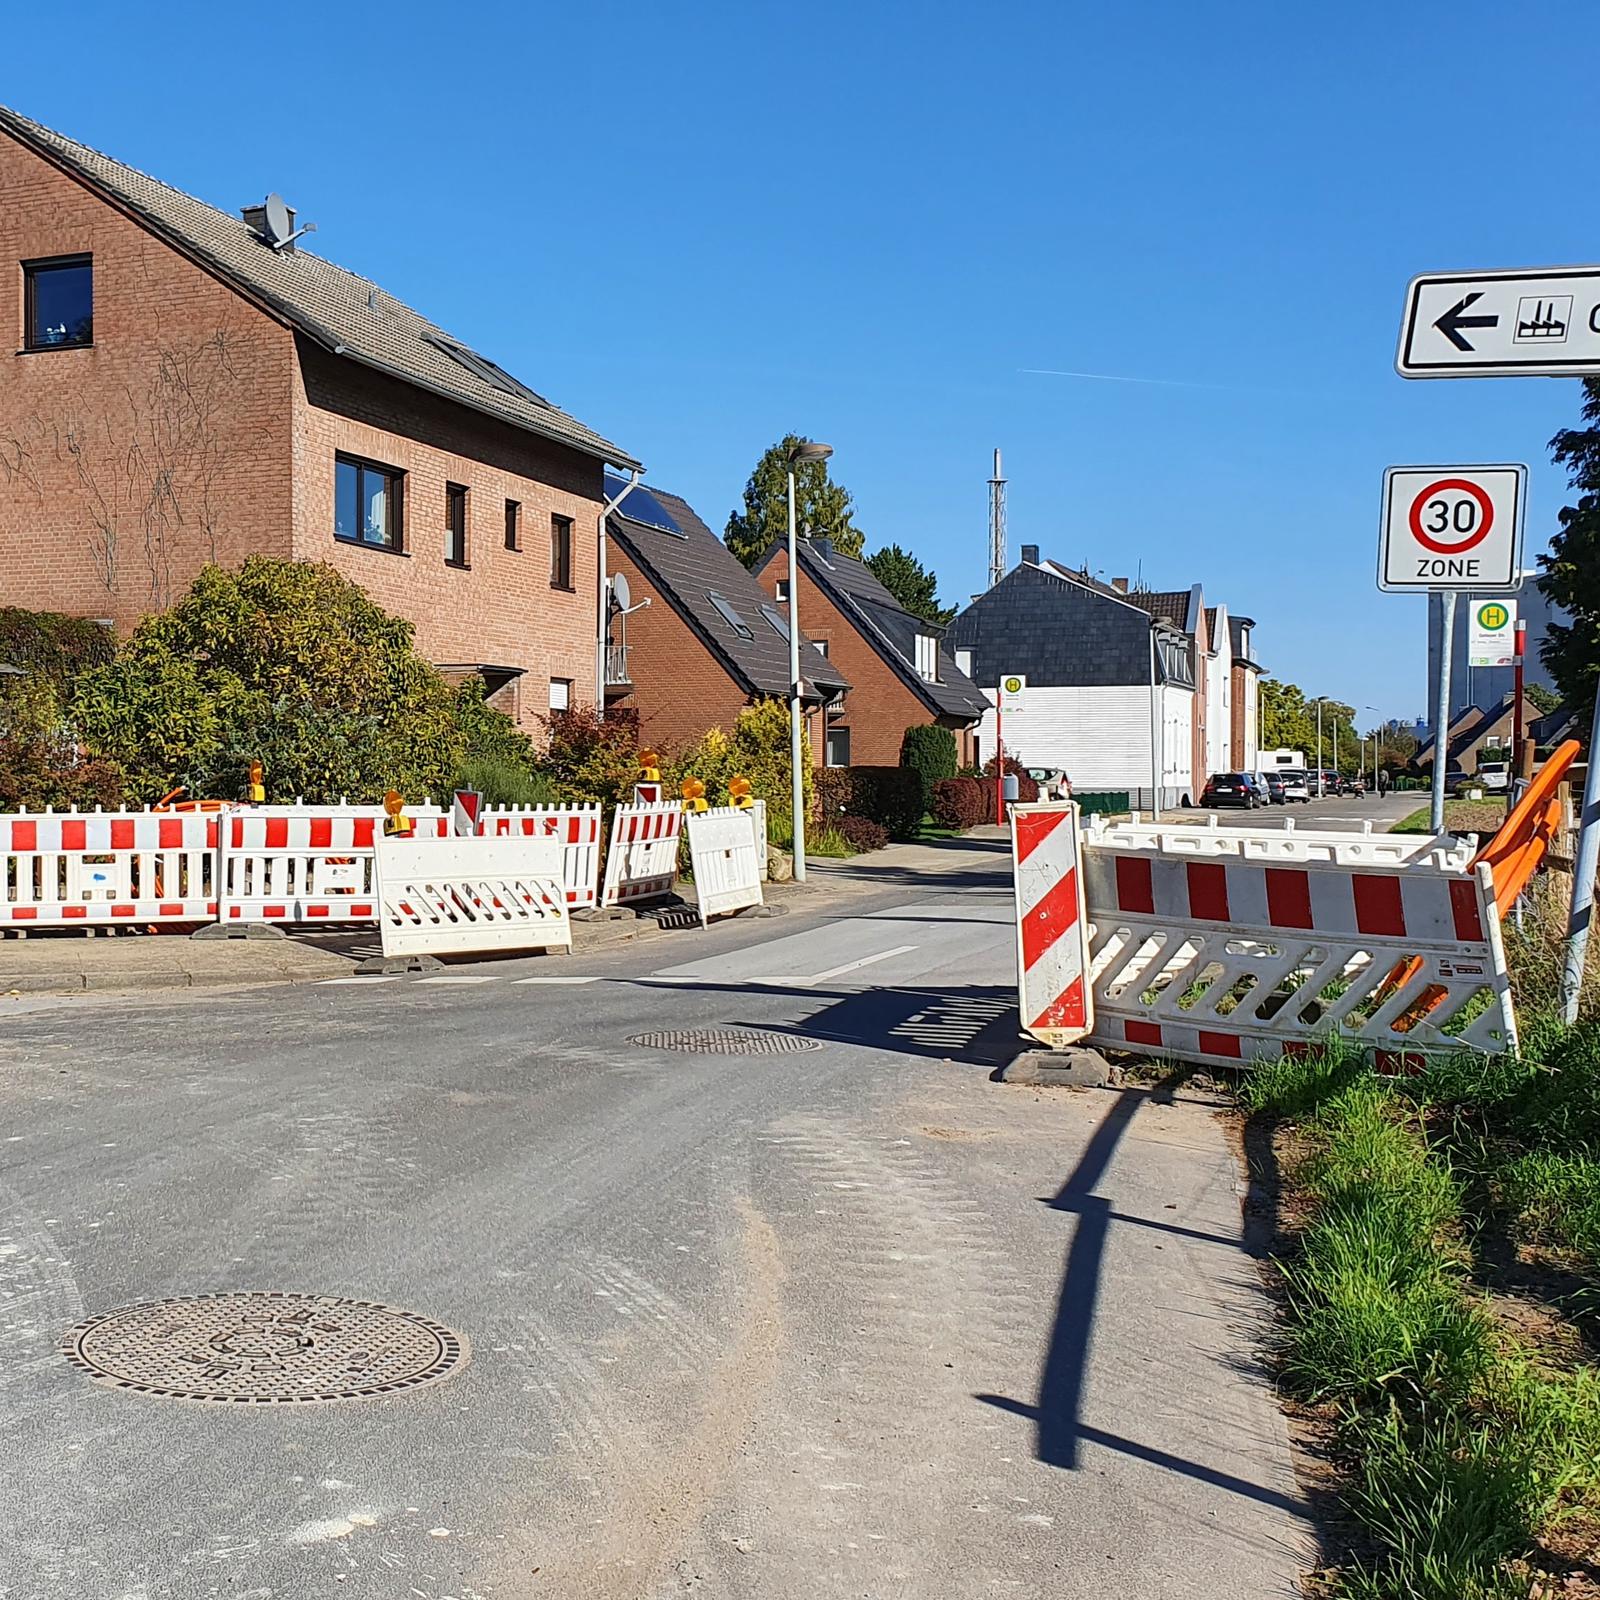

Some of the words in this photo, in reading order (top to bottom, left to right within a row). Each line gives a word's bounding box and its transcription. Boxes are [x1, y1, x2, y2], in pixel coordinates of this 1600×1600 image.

[1426, 500, 1476, 533] 30
[1416, 559, 1481, 577] ZONE
[1486, 608, 1500, 625] H
